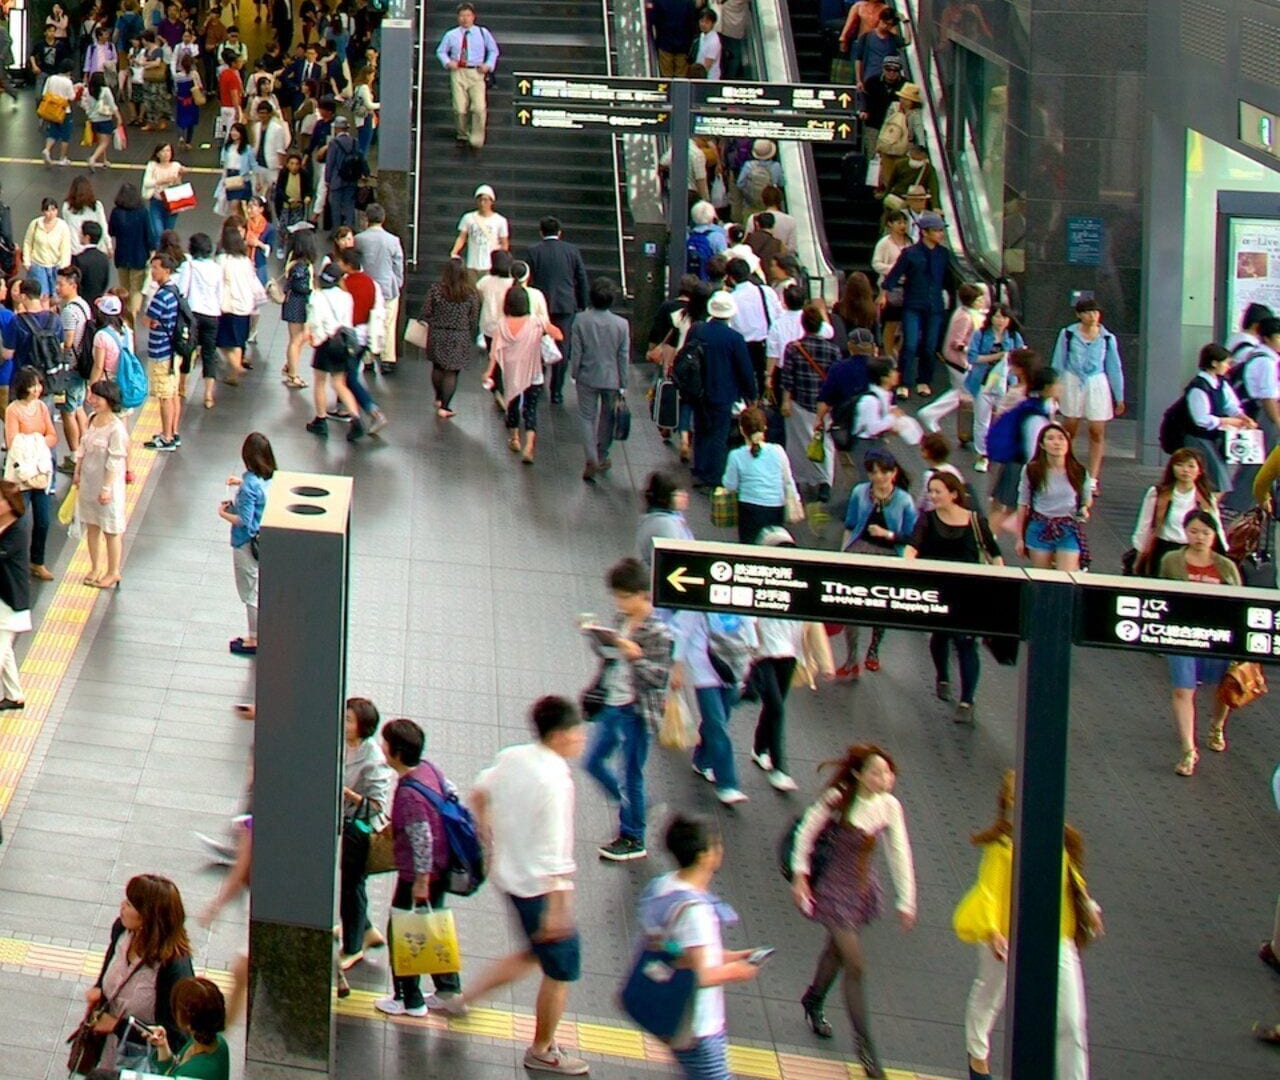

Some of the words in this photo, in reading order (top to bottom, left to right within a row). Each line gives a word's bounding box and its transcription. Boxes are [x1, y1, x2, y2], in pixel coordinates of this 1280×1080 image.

[821, 580, 868, 597] The
[870, 585, 940, 603] CUBE
[1142, 599, 1169, 612] バス
[1141, 610, 1160, 619] Bus
[1141, 634, 1159, 643] Bus
[1142, 623, 1231, 643] バス総合案内所
